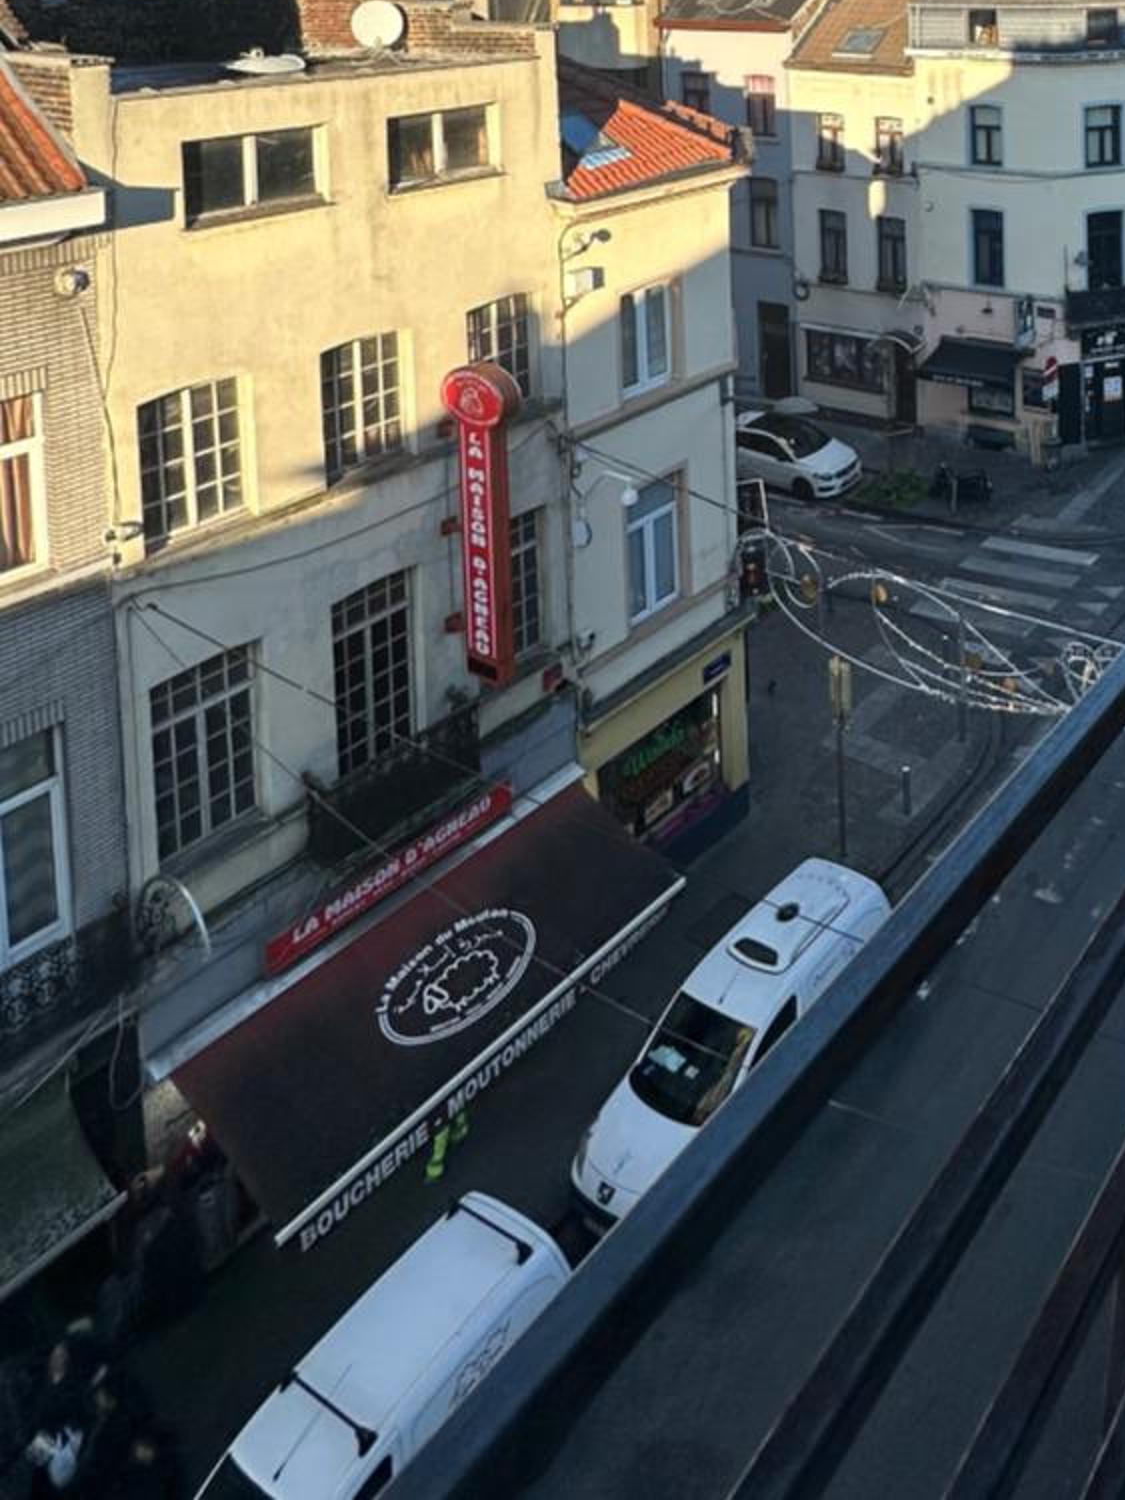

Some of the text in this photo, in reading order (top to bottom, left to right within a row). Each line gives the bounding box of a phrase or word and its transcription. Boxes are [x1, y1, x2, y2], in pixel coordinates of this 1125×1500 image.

[468, 432, 483, 460] LA
[468, 467, 486, 548] MAISON
[291, 914, 320, 945] LA
[324, 859, 401, 921] MAISON
[404, 797, 492, 866] D'AGNEAU
[384, 943, 434, 991] Maison
[453, 908, 509, 932] Mouton
[299, 1120, 430, 1253] BOUCHERIE
[446, 988, 577, 1119] MOUTONNERIE
